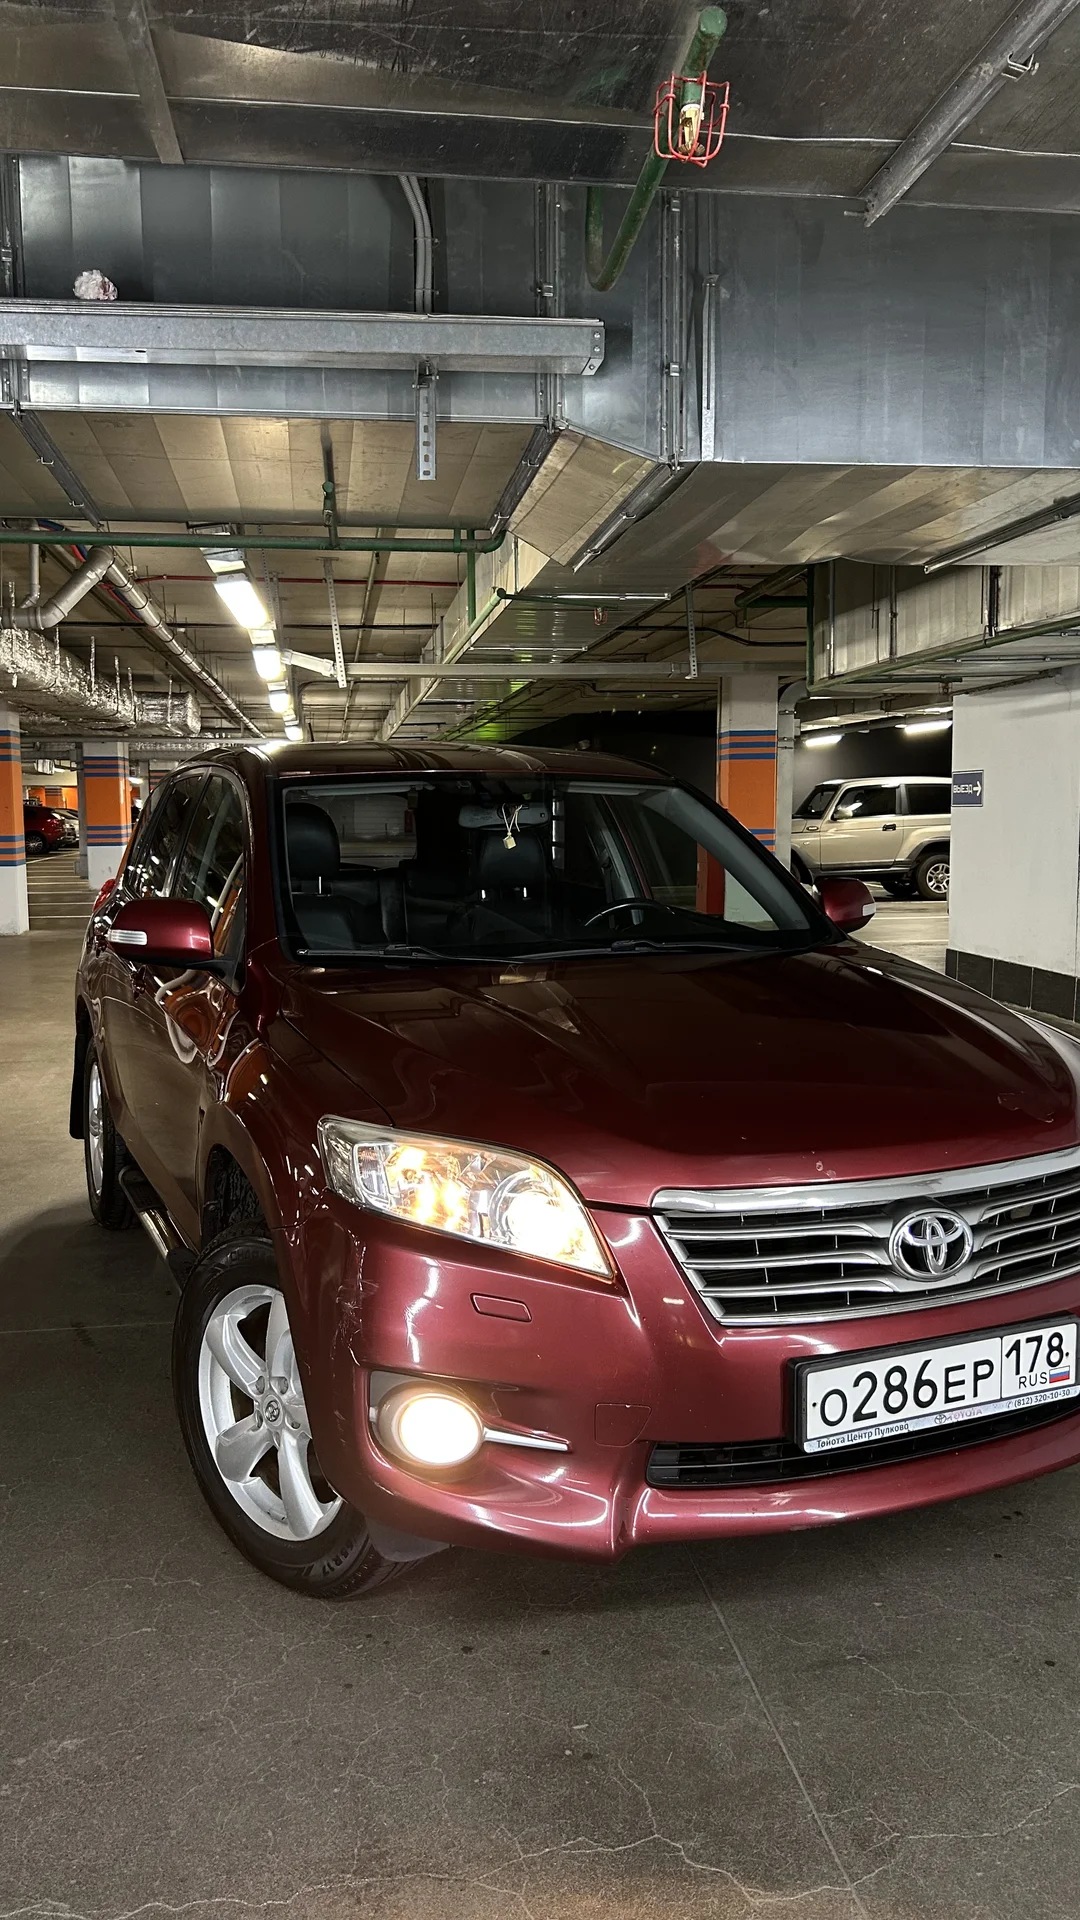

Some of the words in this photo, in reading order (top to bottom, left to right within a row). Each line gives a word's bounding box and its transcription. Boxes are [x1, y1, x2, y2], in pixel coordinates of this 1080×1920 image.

[953, 784, 973, 794] ВЫЕЗД
[1005, 1332, 1064, 1376] 178
[1019, 1371, 1048, 1389] RUS
[1014, 1395, 1033, 1408] (812)
[1034, 1389, 1071, 1404] 320-10-30
[816, 1437, 846, 1449] Тойота
[847, 1429, 873, 1443] Центр
[874, 1423, 909, 1438] Пулково
